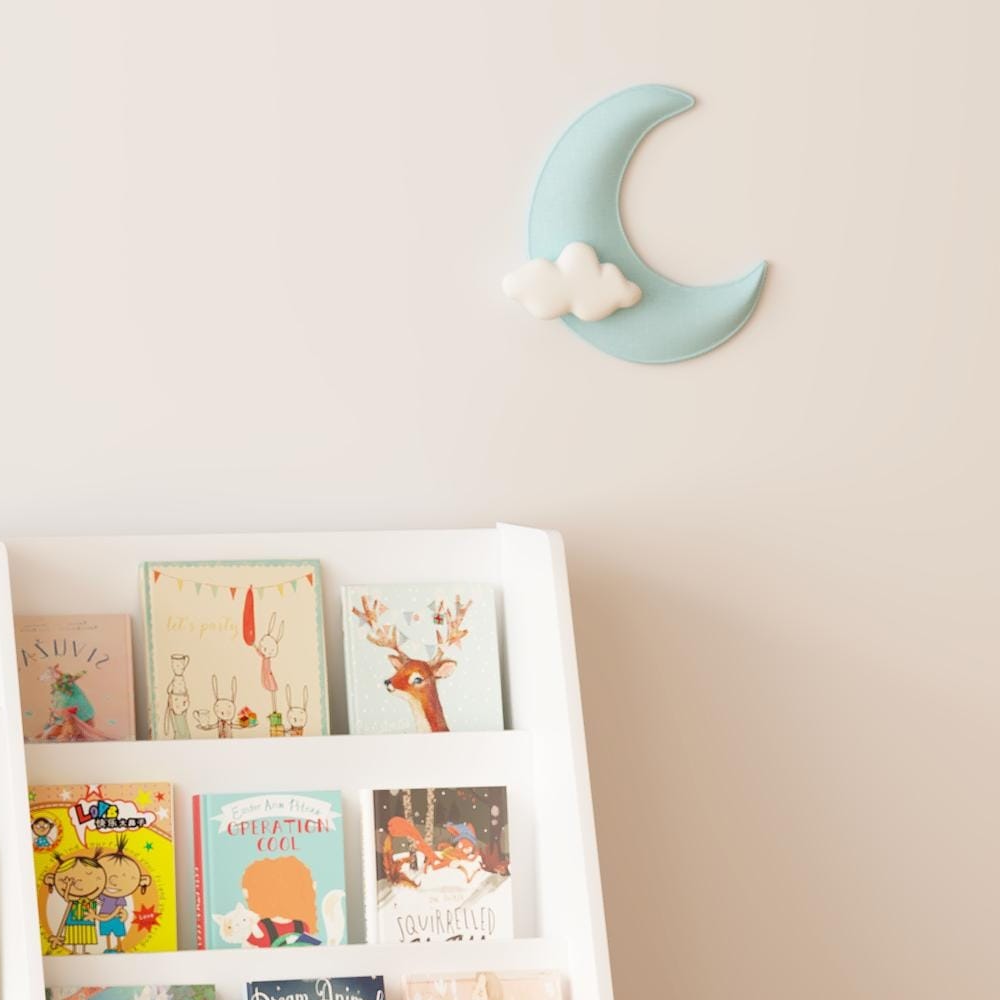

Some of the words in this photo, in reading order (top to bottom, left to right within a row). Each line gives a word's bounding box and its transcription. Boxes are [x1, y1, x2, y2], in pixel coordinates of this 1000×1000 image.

[226, 818, 330, 837] OPERATION
[257, 837, 300, 852] COOL
[397, 906, 496, 943] SQUIRRELLED
